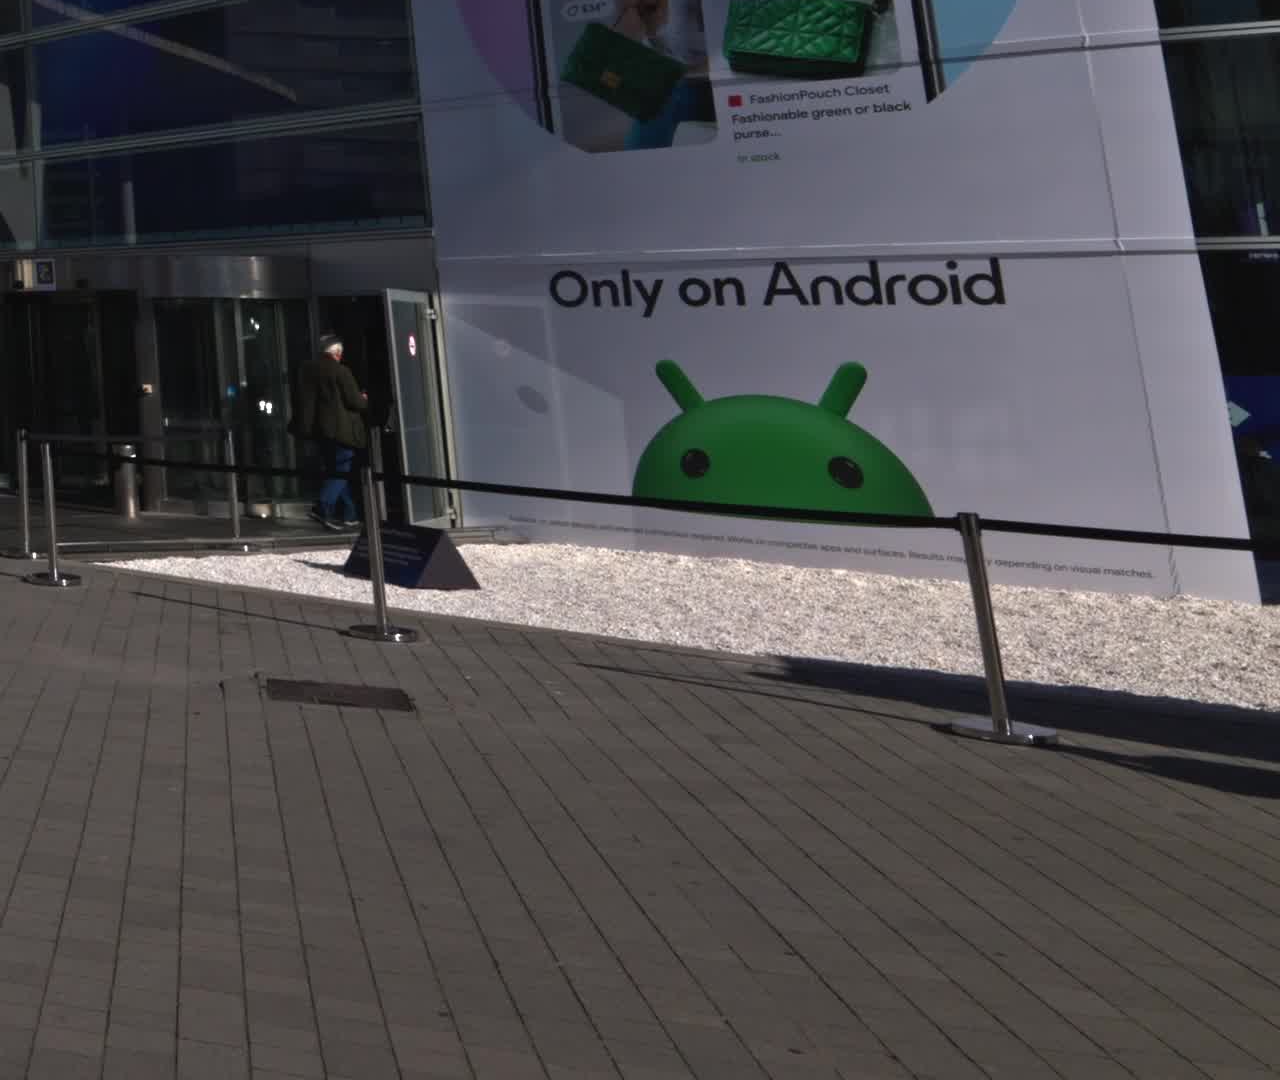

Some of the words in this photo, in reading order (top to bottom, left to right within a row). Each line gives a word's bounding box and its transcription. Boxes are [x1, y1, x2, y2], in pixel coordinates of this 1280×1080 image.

[749, 87, 842, 105] FashionPouch
[844, 83, 890, 96] Closet
[731, 108, 809, 125] Fashionable
[812, 106, 853, 121] green
[855, 103, 869, 115] or
[872, 99, 912, 113] black
[548, 268, 664, 318] Only
[678, 275, 746, 307] on
[763, 255, 1007, 307] Android
